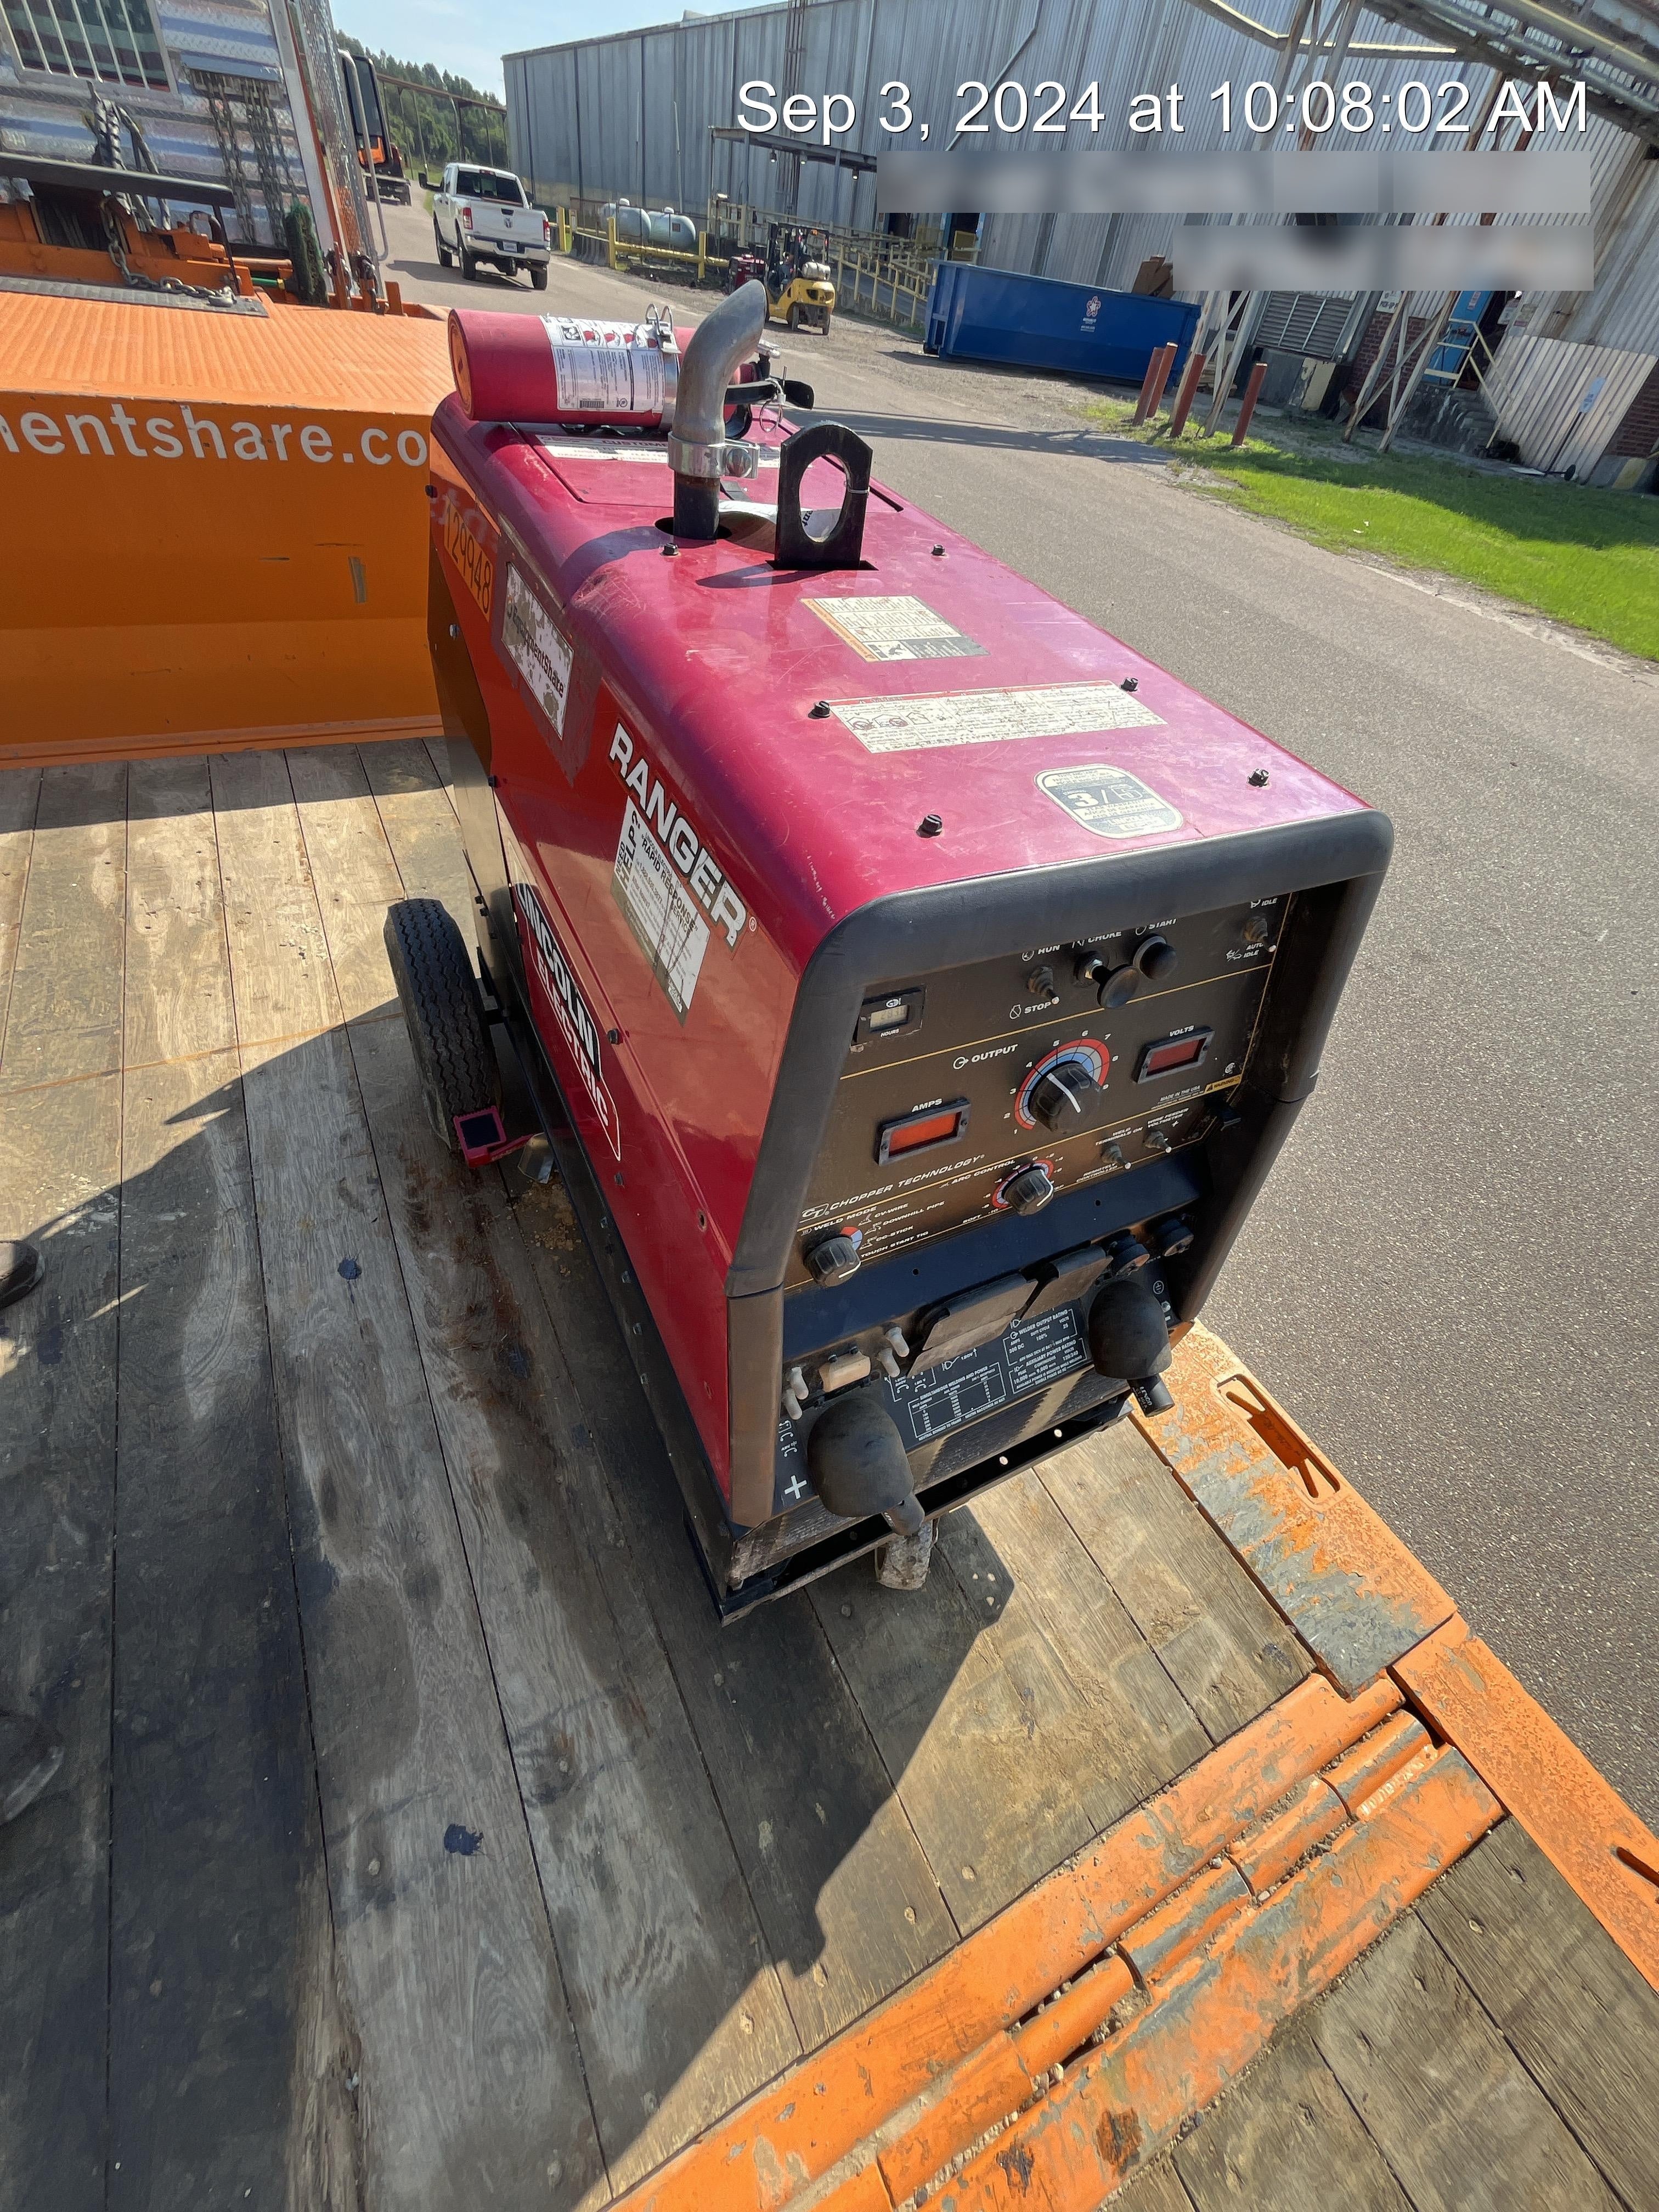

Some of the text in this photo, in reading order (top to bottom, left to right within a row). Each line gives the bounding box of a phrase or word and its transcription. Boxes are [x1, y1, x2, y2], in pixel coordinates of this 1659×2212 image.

[447, 503, 492, 615] 129948
[619, 807, 641, 892] HELP?
[645, 830, 658, 857] LINCOLN
[615, 839, 626, 878] NEED
[1261, 898, 1278, 906] IDLE
[669, 899, 691, 939] SERVICE
[1243, 950, 1260, 958] IDLE
[516, 882, 595, 1065] LINCOLN
[1024, 1001, 1052, 1014] STOP
[535, 945, 608, 1127] ELECTRIC
[880, 1028, 900, 1037] HOURS
[1104, 1032, 1112, 1041] 7
[1169, 1025, 1195, 1037] VOLTS
[970, 1043, 1019, 1063] OUTPUT
[911, 1098, 943, 1113] AMPS
[1147, 1107, 1189, 1125] WIRE FEEDER
[1094, 1130, 1132, 1146] TERMINALS
[1112, 1126, 1131, 1137] WELD
[951, 1159, 1016, 1185] ARC CONTROL
[829, 1184, 894, 1211] CHOPPER
[814, 1206, 878, 1231] WELD MODE
[882, 1200, 945, 1226] DOWNHILL PIPE
[962, 1214, 983, 1224] SOFT
[860, 1231, 929, 1259] TOUCH START TIG
[1018, 1308, 1069, 1335] WELDER OUTPUT RATING
[1017, 1342, 1025, 1351] DC
[1036, 1333, 1048, 1341] 100%
[1025, 1353, 1047, 1367] AUXILIARY
[1046, 1346, 1062, 1357] POWER
[1062, 1339, 1076, 1349] RATING
[919, 1384, 949, 1400] SIMULTANEOUS
[948, 1376, 966, 1389] WELDING
[965, 1372, 975, 1380] AND
[974, 1365, 989, 1376] POWER
[1139, 1386, 1153, 1406] LENCO
